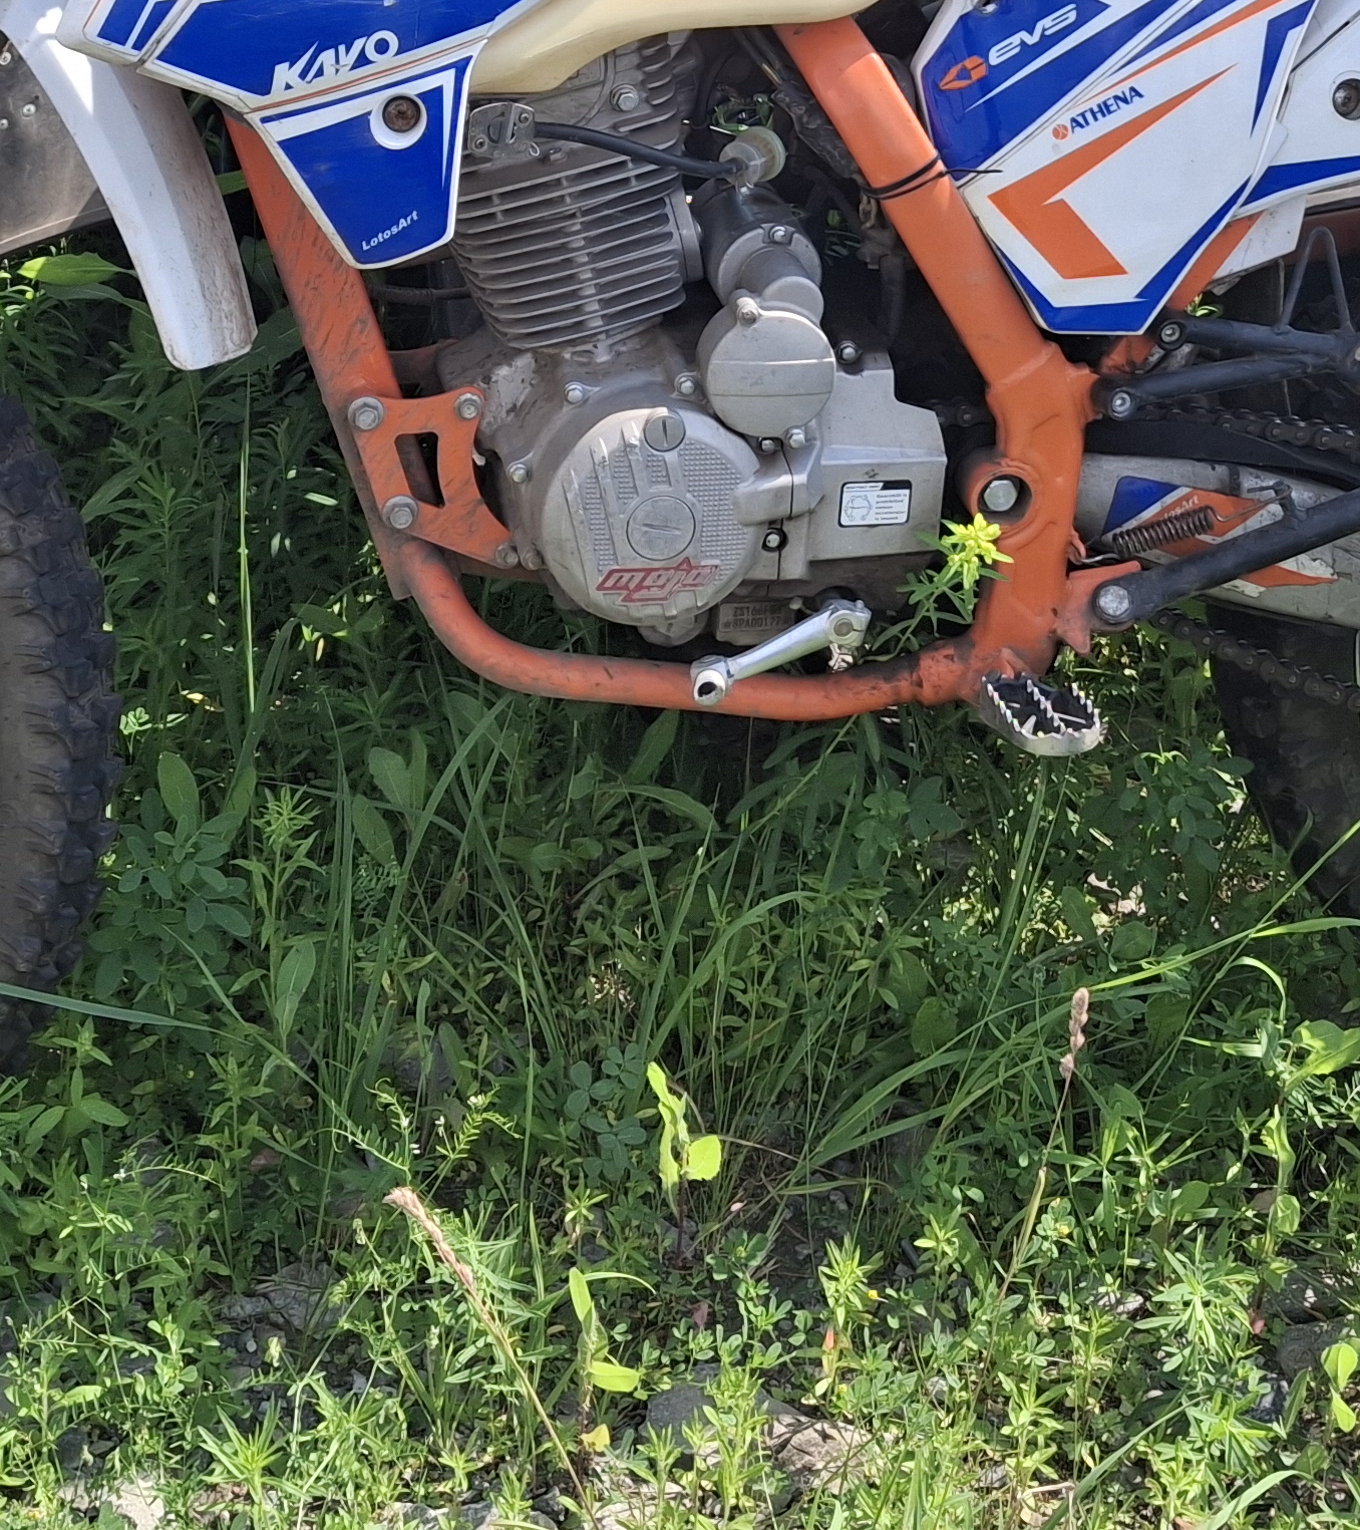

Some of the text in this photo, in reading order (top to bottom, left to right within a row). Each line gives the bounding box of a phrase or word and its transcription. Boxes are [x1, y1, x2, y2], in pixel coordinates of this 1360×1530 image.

[269, 29, 398, 96] KAYO
[1069, 85, 1145, 135] ATHENA
[361, 210, 419, 251] LotosArt
